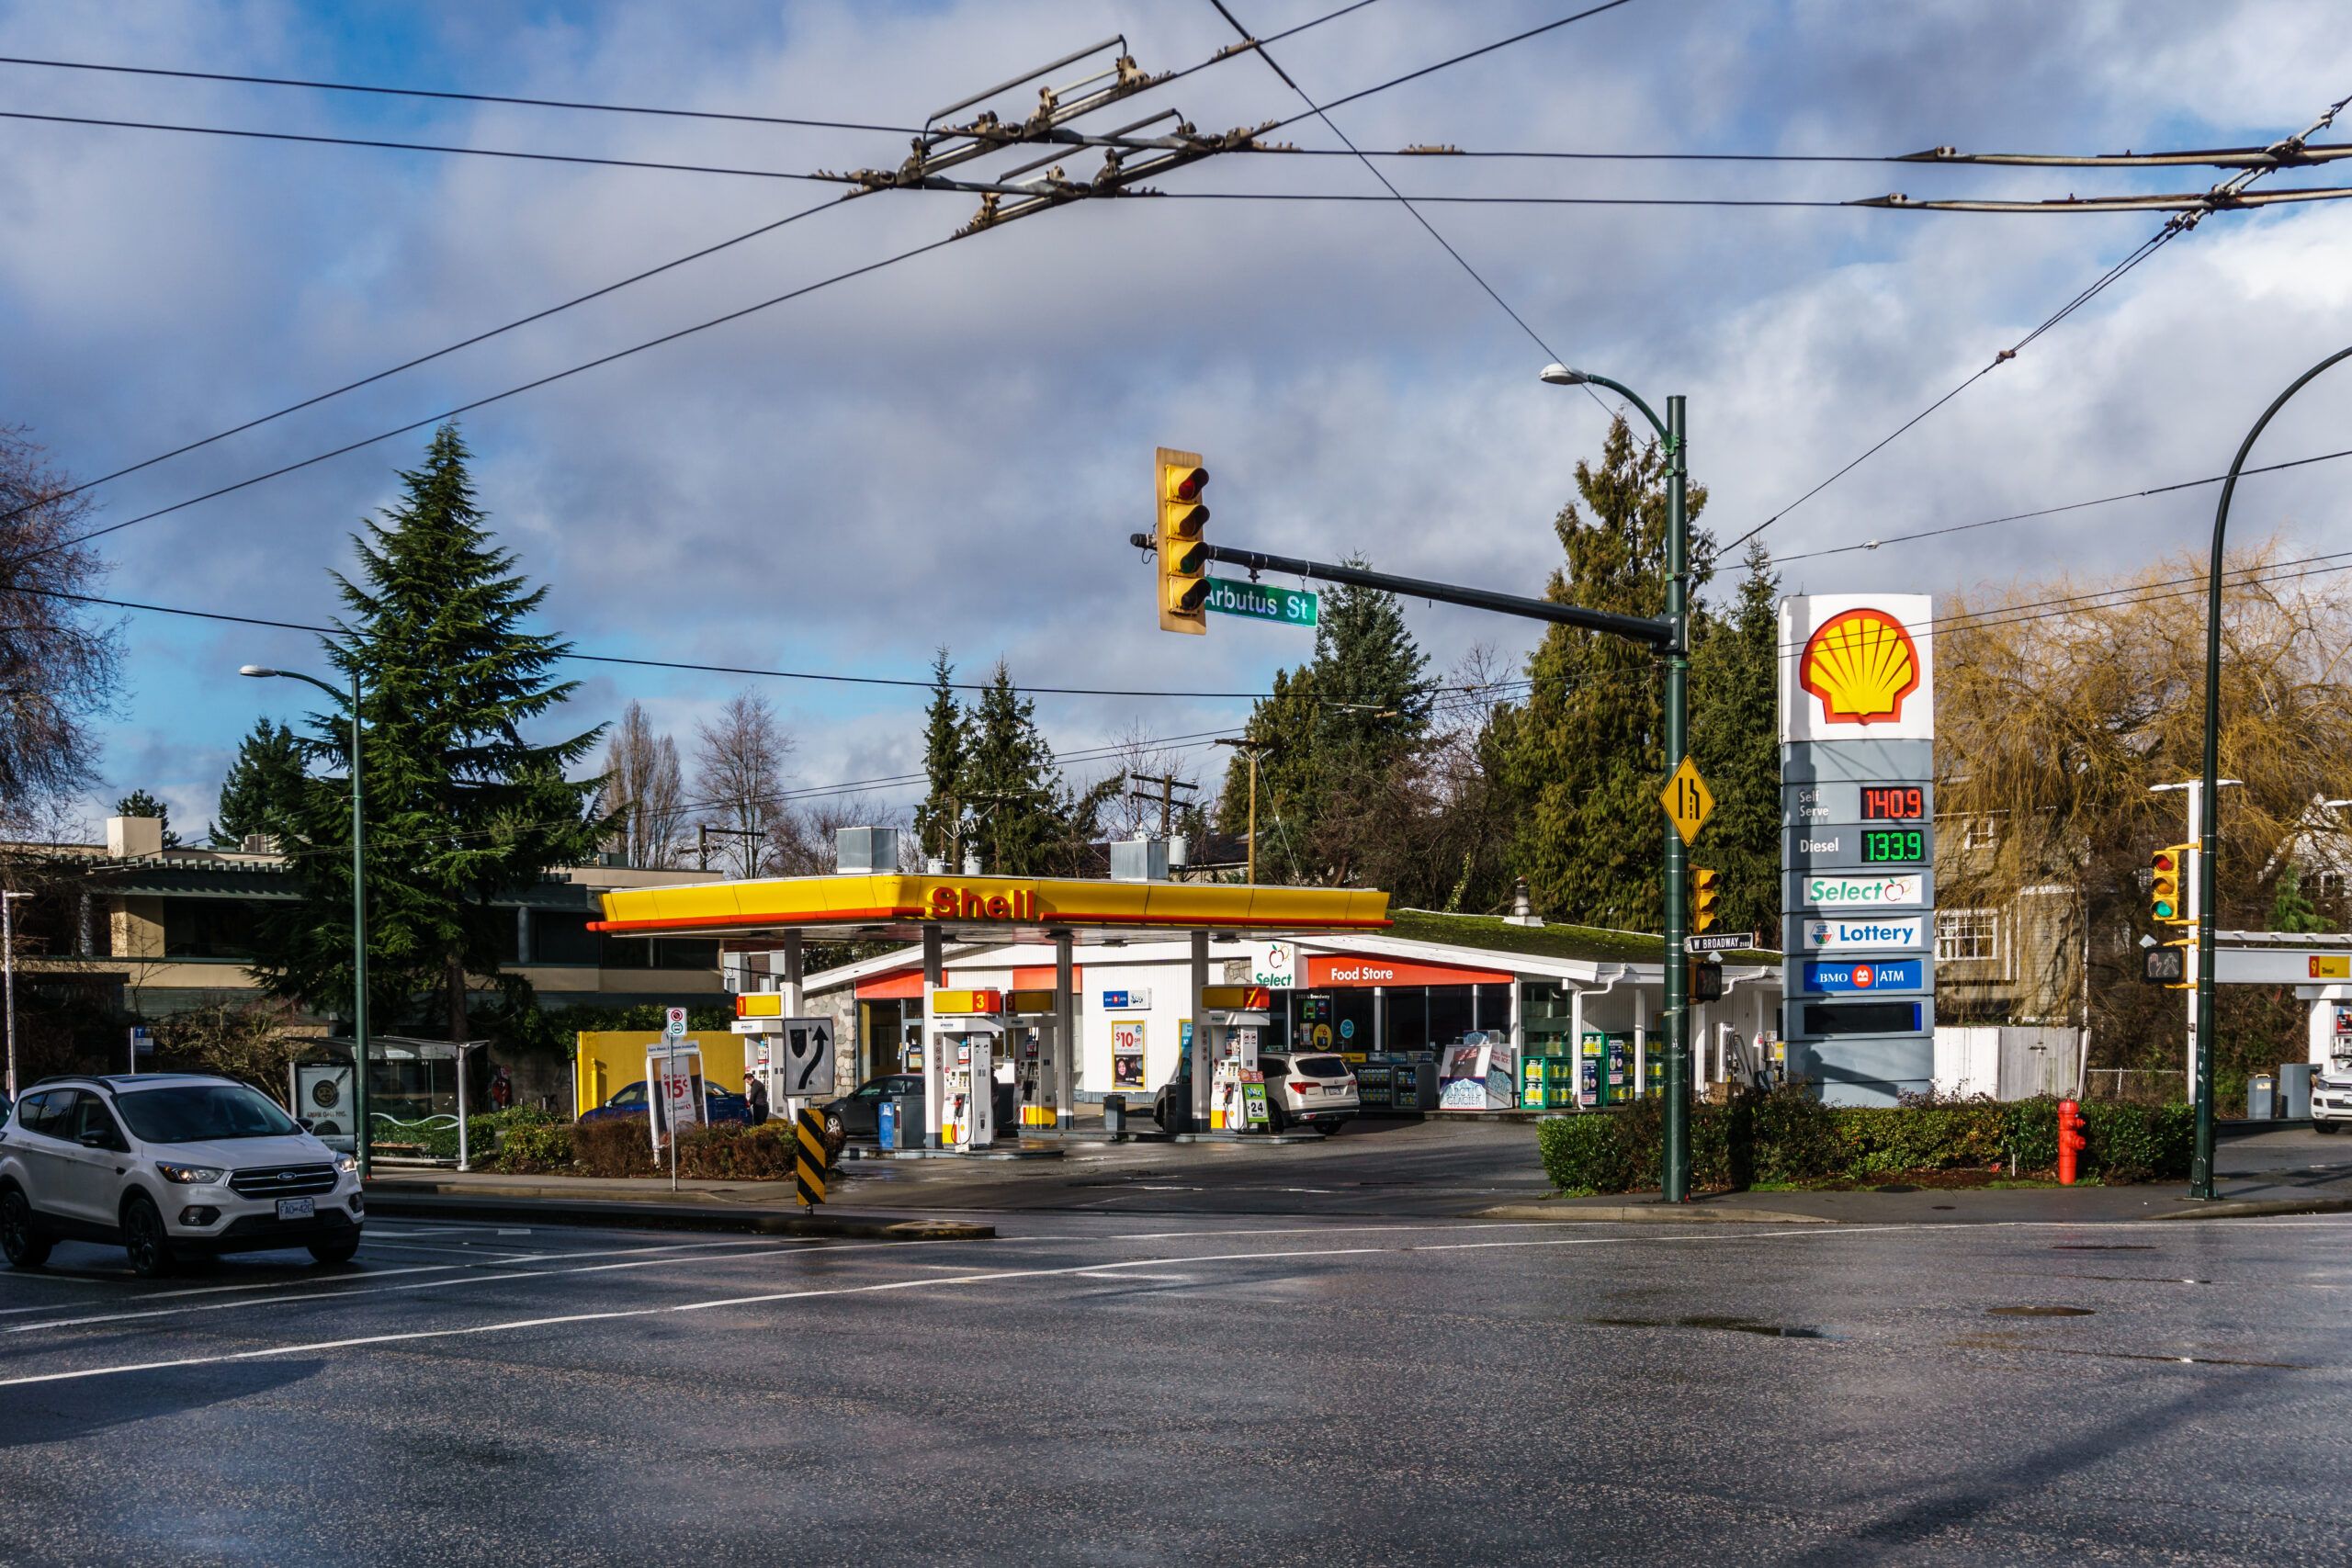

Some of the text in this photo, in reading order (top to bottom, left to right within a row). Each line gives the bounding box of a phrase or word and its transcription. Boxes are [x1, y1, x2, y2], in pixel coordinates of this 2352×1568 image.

[1204, 585, 1308, 619] Arbutus St
[1799, 790, 1820, 803] Self
[1866, 789, 1922, 818] 140.9
[1799, 806, 1829, 817] Serve
[1800, 837, 1839, 852] Diesel
[1867, 832, 1921, 861] 133.9
[1810, 881, 1883, 901] Select
[930, 886, 1035, 919] Shell
[1839, 924, 1914, 944] Lottery
[1693, 939, 1701, 950] W
[1702, 937, 1739, 949] BROADWAY
[1330, 966, 1393, 980] Food Store
[2311, 960, 2317, 974] 9
[1255, 973, 1292, 987] Select
[1819, 970, 1905, 983] BMO ATM
[739, 999, 743, 1013] 1
[976, 994, 985, 1009] 3
[1446, 1086, 1482, 1097] ARCTIC
[1250, 1101, 1263, 1113] 24
